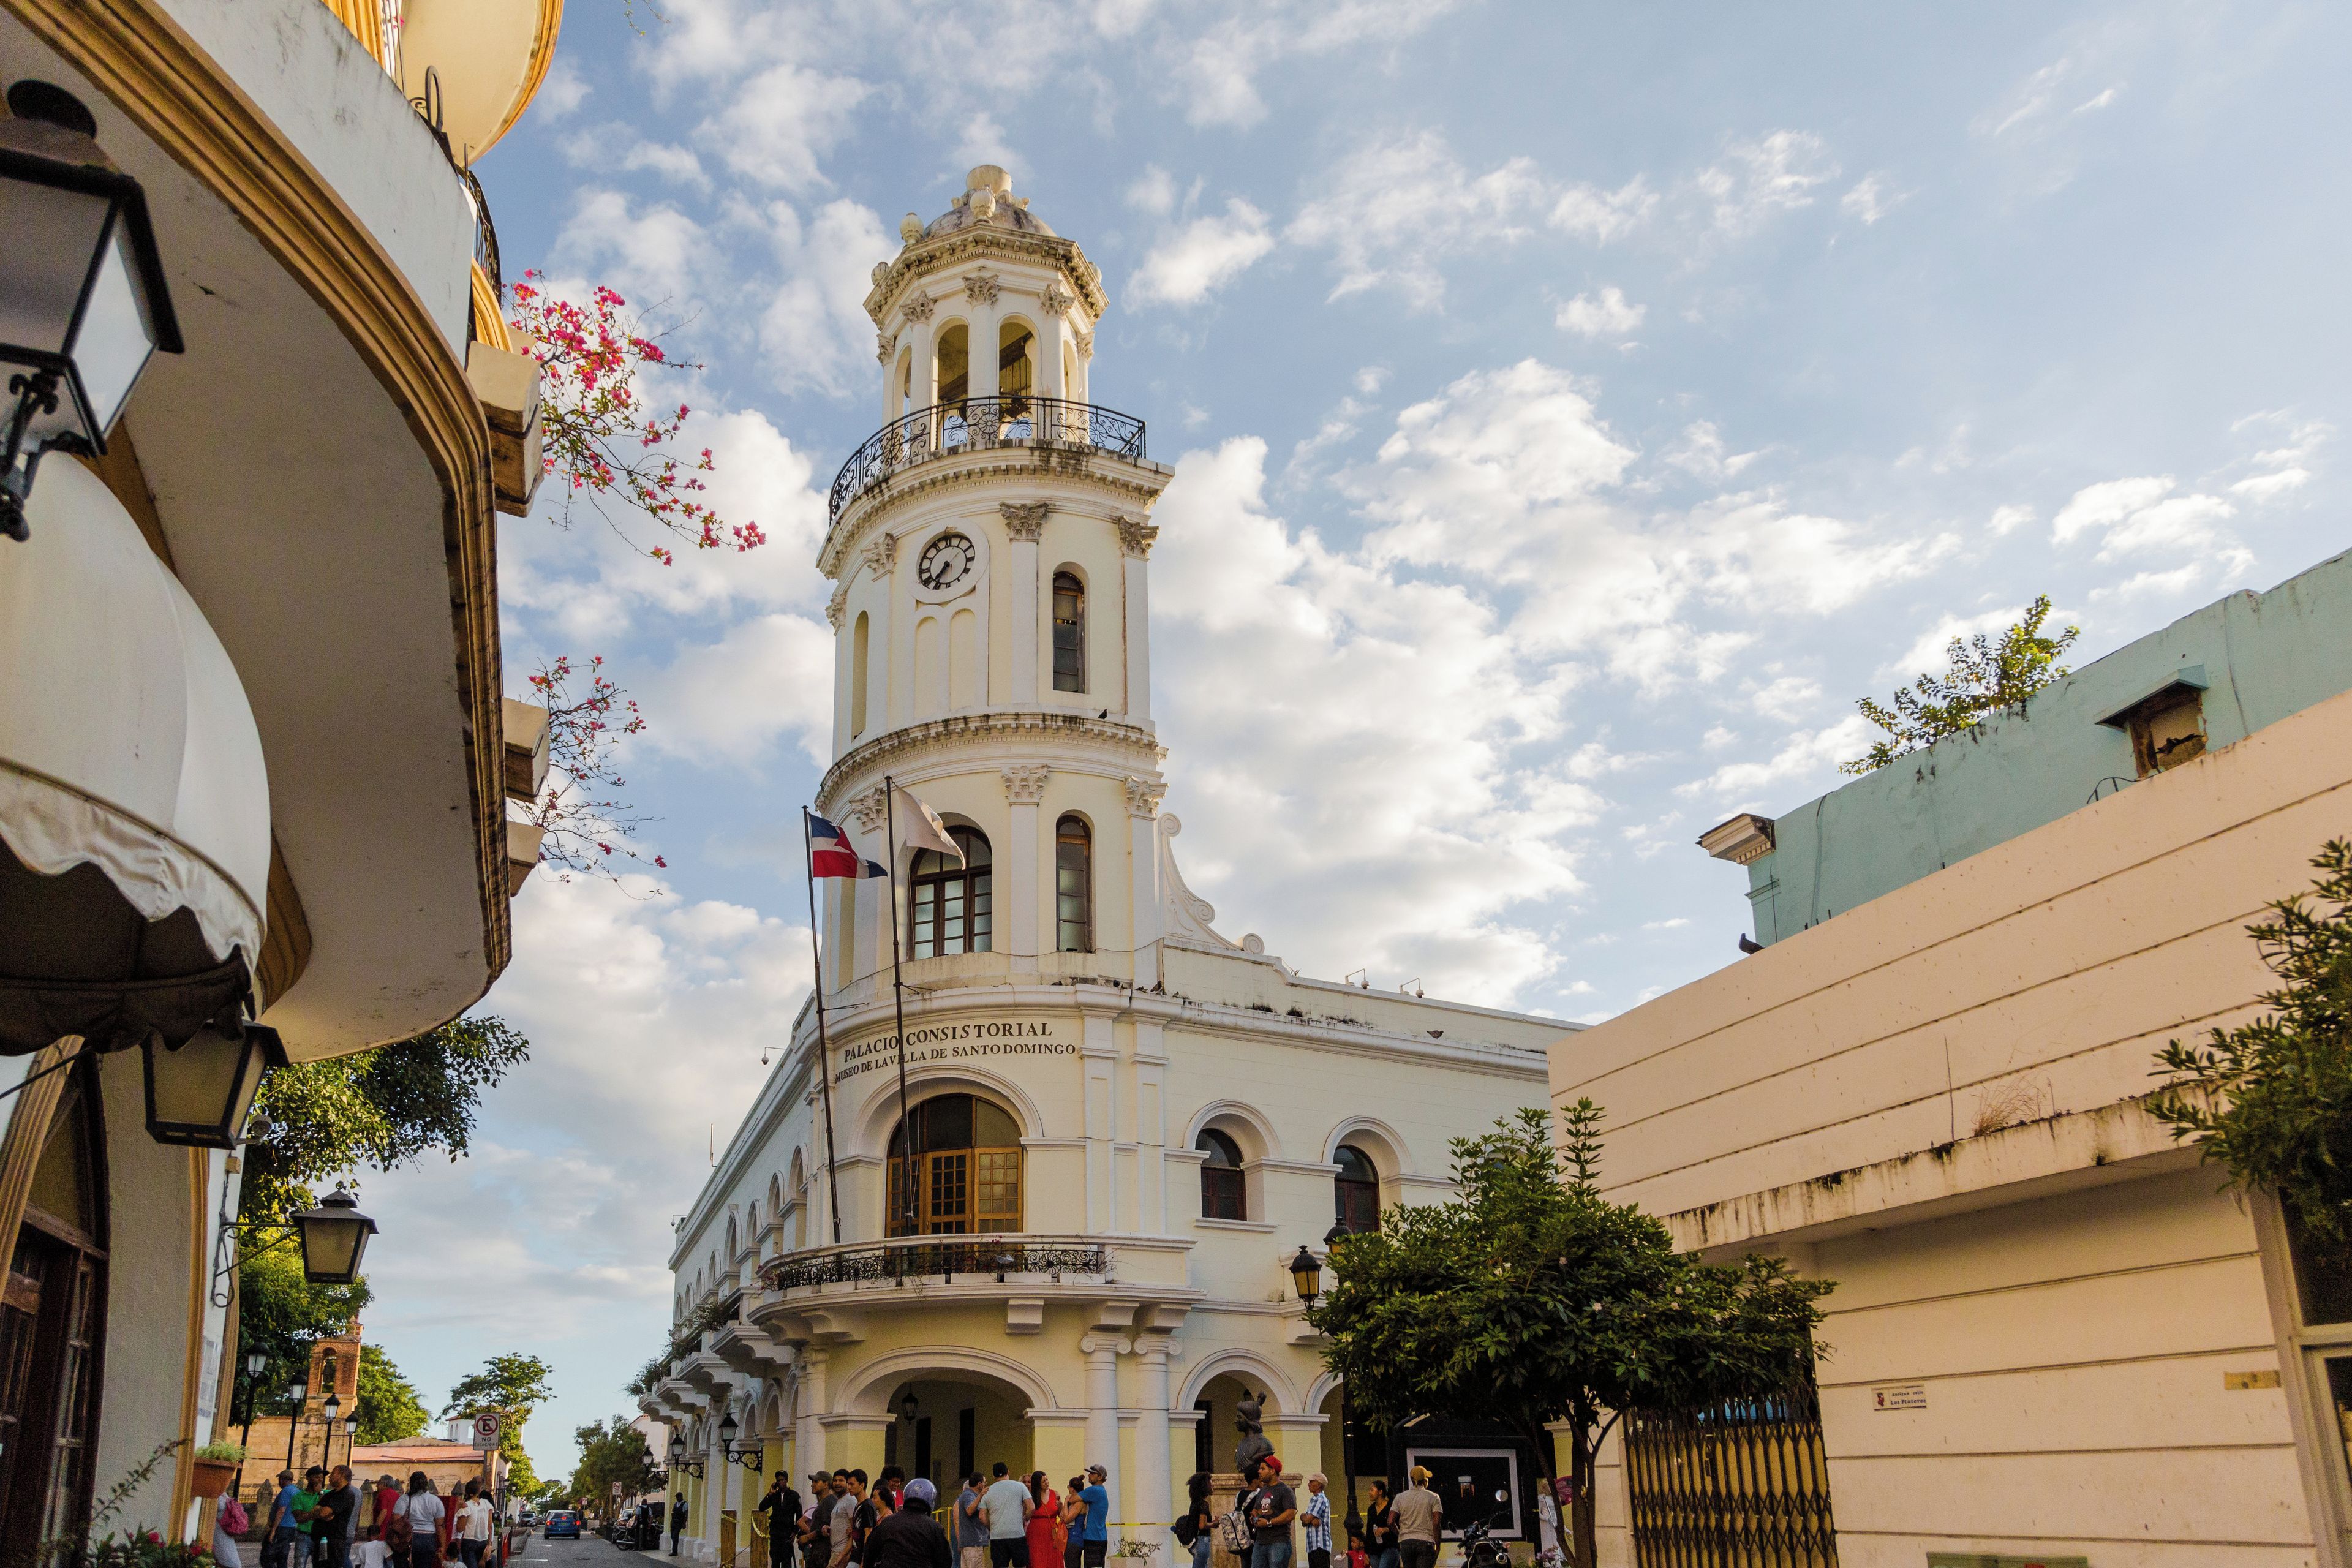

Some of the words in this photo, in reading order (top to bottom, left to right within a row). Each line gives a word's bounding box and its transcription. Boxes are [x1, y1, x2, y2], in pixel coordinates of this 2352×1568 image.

[845, 1036, 899, 1063] PALACIO
[906, 1023, 1052, 1046] CONSISTORIAL
[835, 1065, 859, 1084] MUSEO
[861, 1061, 873, 1073] DE
[875, 1057, 888, 1069] LA
[930, 1048, 948, 1060] DE
[952, 1044, 1001, 1057] SANTO
[1003, 1044, 1076, 1055] DOMINGO
